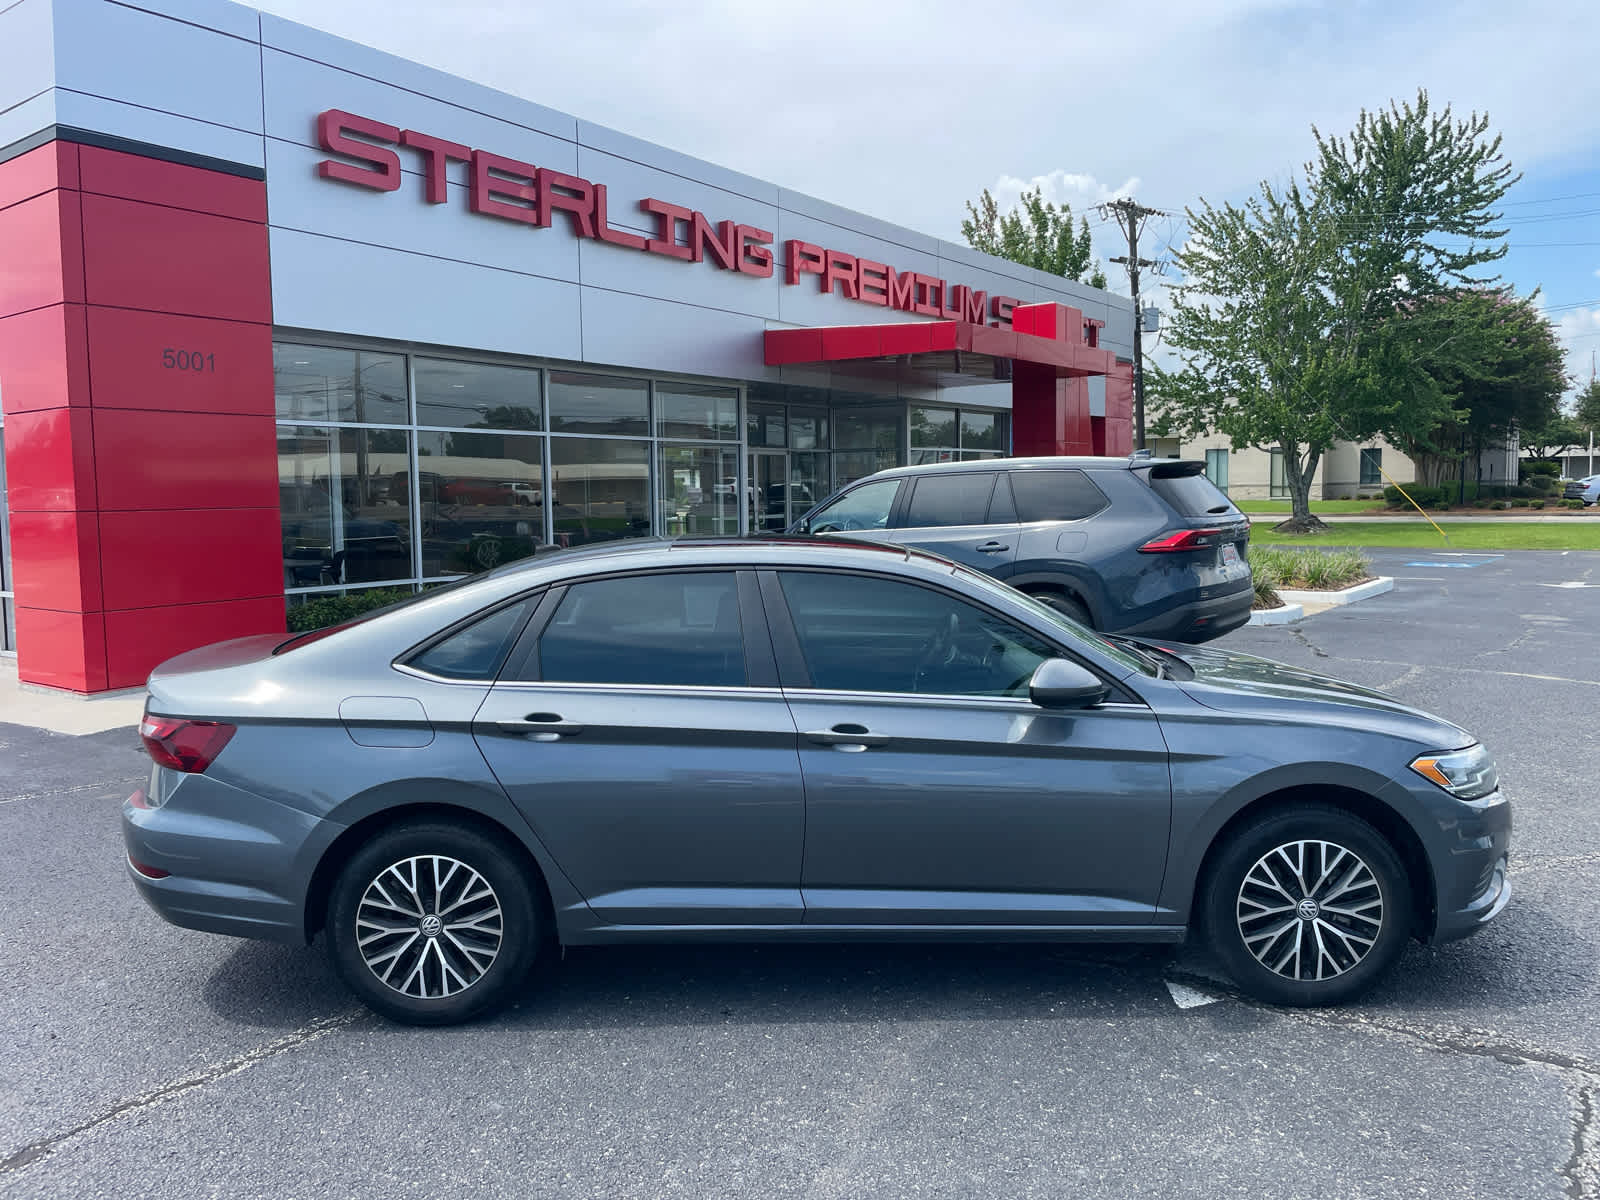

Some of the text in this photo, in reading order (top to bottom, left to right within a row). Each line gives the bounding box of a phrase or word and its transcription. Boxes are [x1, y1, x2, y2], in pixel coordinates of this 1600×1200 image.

[318, 108, 774, 278] STERLING
[785, 239, 987, 327] PREMIUM
[163, 348, 215, 373] 5001
